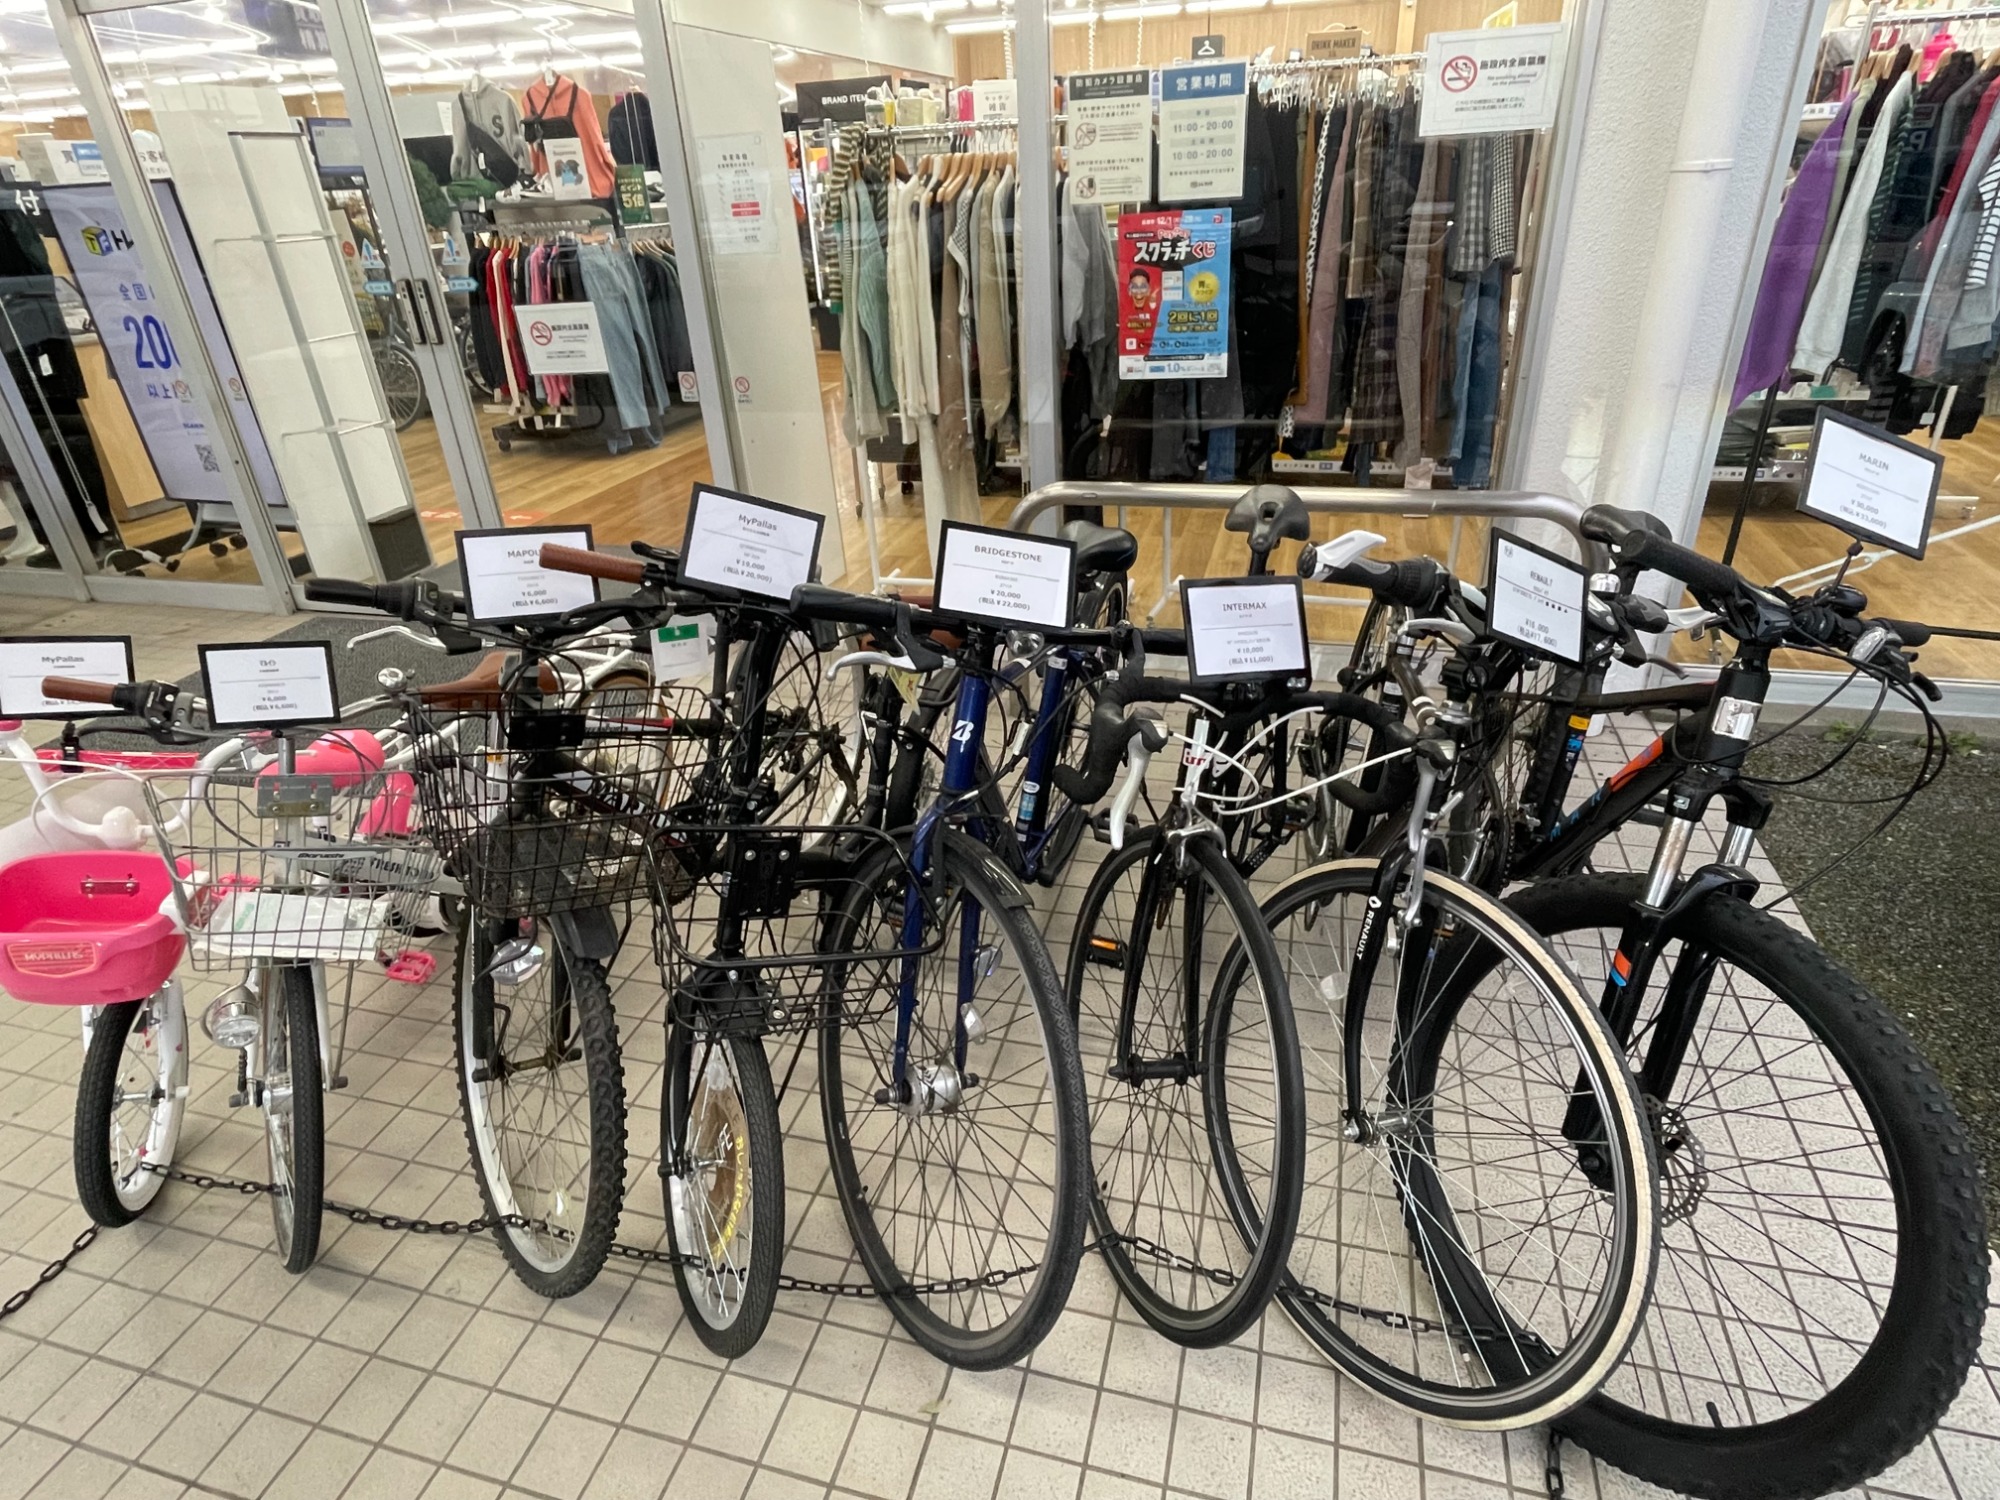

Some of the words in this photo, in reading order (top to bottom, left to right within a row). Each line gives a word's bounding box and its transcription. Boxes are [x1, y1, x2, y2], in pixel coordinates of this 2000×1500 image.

[1311, 39, 1331, 50] DRINK
[1333, 38, 1356, 49] MAKER
[1176, 73, 1232, 91] 営業時間
[821, 95, 848, 105] BRAND
[492, 114, 505, 138] S
[621, 192, 645, 208] 5倍
[1859, 453, 1889, 472] MARIN
[738, 514, 778, 531] MyPallas
[974, 545, 1043, 563] BRIDGESTONE
[1530, 570, 1553, 588] RENAULT
[1222, 602, 1267, 612] INTERMAX
[41, 656, 85, 664] MyPallas
[1356, 910, 1375, 960] RENAULT
